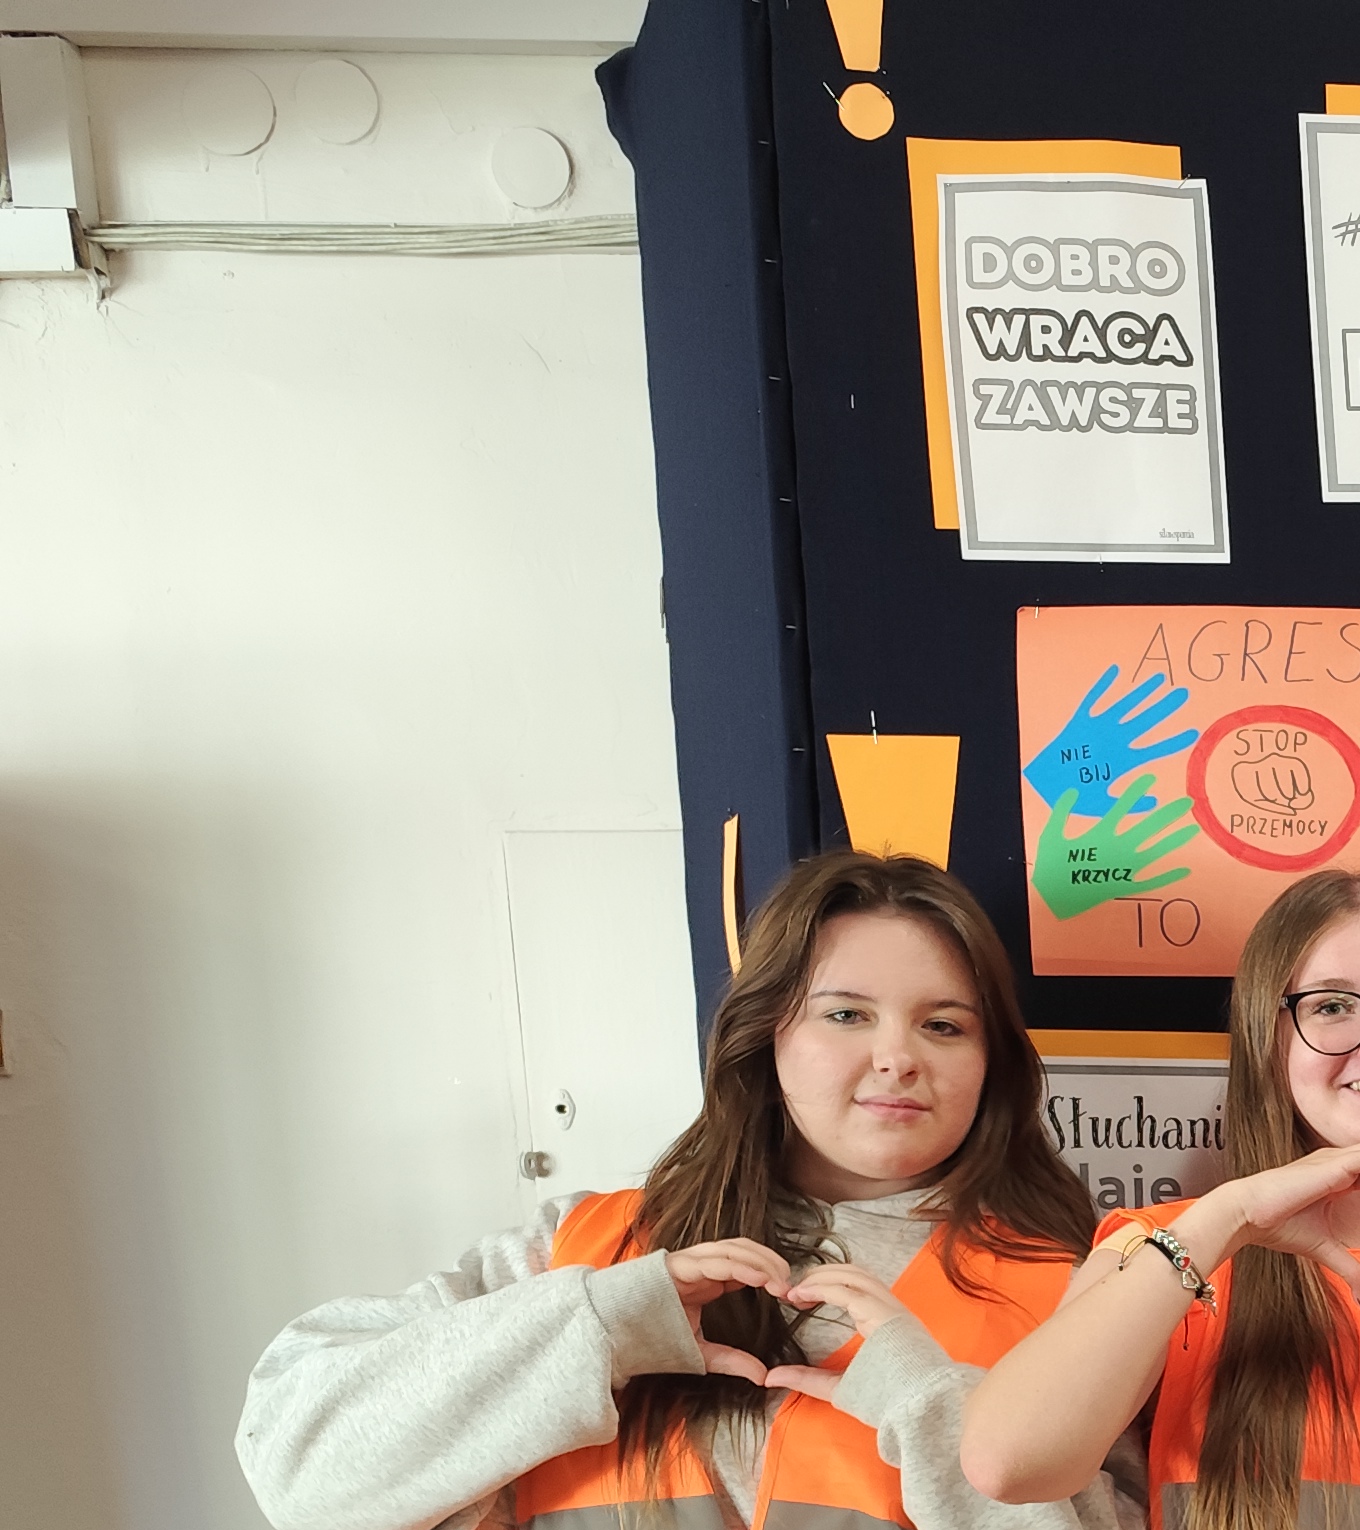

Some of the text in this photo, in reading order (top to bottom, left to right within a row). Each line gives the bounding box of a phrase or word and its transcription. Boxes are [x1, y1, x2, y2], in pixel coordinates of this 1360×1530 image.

[965, 237, 1185, 296] DOBRO
[967, 307, 1193, 367] WRACA
[973, 378, 1198, 435] ZAWSZE
[1060, 744, 1092, 764] NIE
[1234, 729, 1307, 755] STOP
[1079, 763, 1111, 783] BIJ
[1230, 814, 1327, 838] PRZEMOCY
[1067, 847, 1097, 863] NIE
[1071, 867, 1132, 884] KRZYCZ
[1114, 897, 1200, 947] TO
[1048, 1096, 1226, 1155] Słuchani
